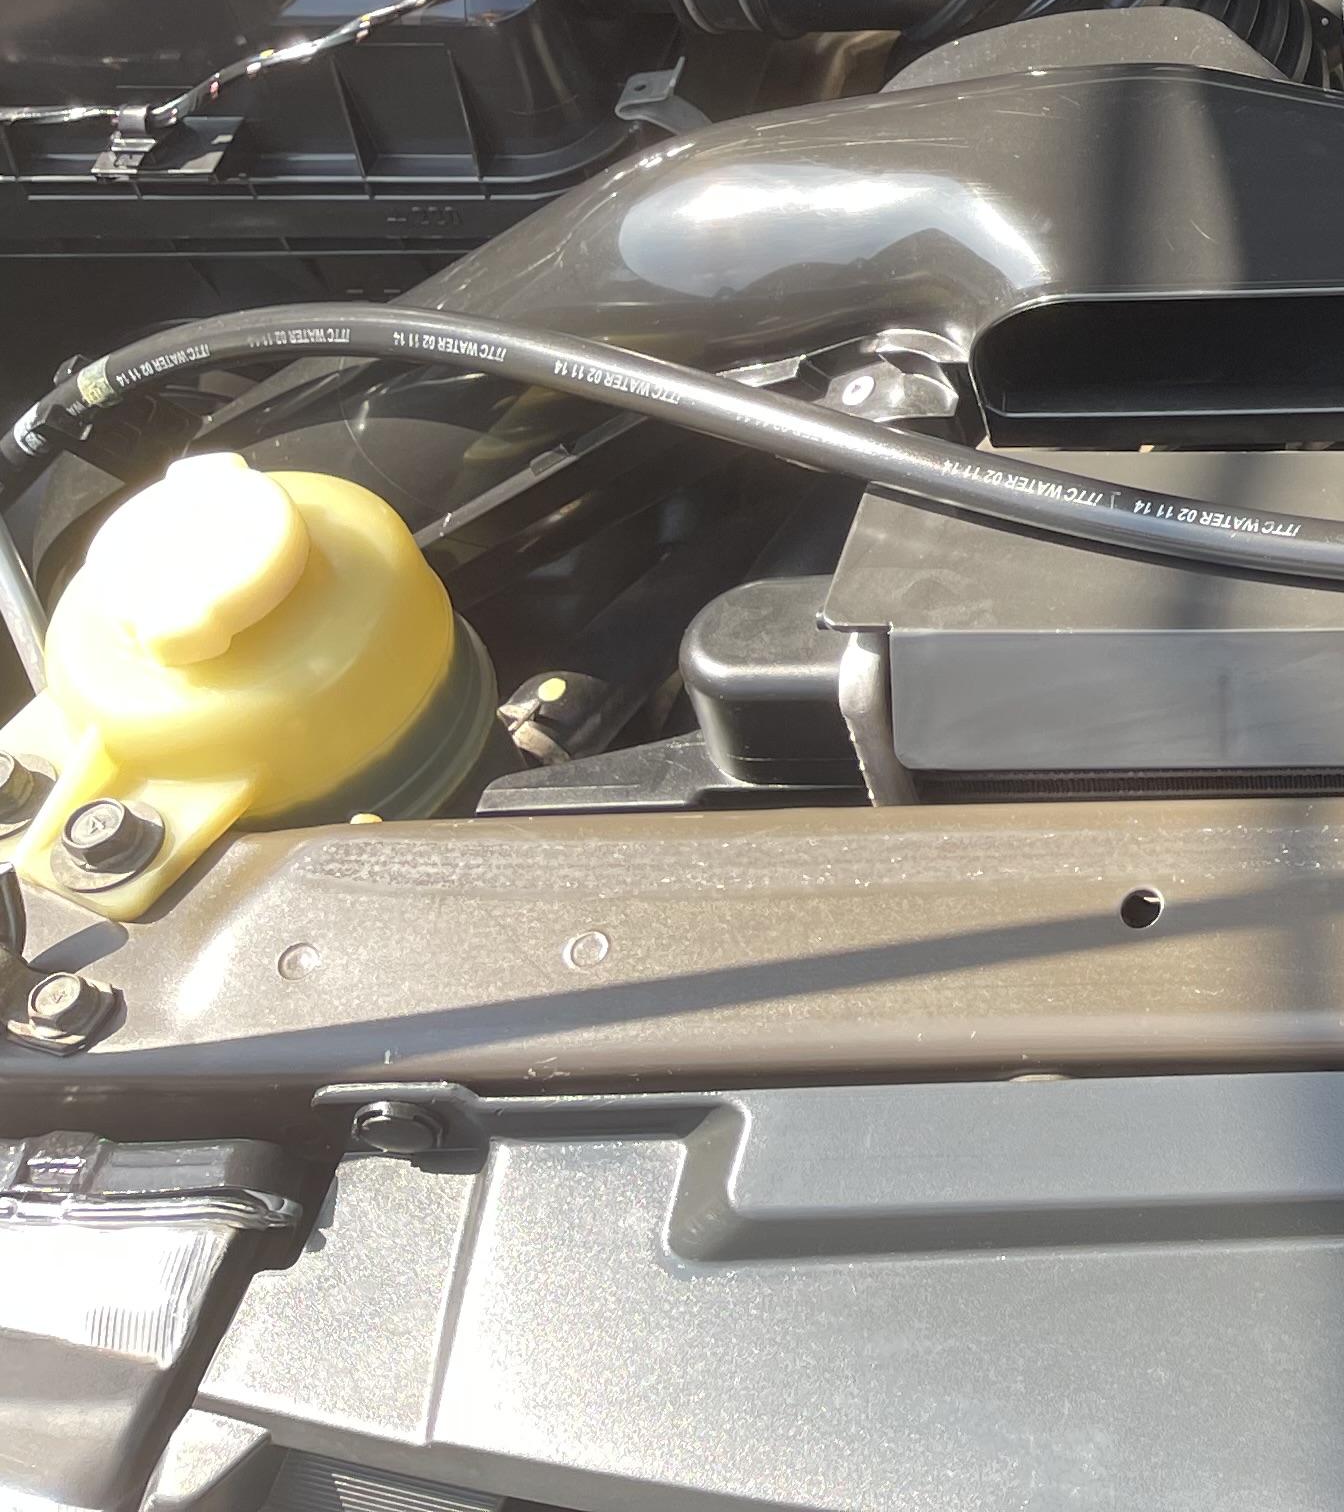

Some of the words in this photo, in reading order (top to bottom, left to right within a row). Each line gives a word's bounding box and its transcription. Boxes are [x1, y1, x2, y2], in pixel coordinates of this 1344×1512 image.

[288, 328, 328, 345] WATER
[393, 331, 406, 346] 14
[408, 332, 420, 348] 11
[422, 334, 436, 349] 02
[438, 336, 480, 360] WATER
[141, 362, 153, 376] 02
[151, 350, 187, 373] WATER
[554, 359, 569, 376] 14
[570, 364, 585, 380] 11
[586, 367, 604, 385] 02
[604, 371, 652, 398] WATER
[962, 463, 981, 481] 11
[984, 468, 1003, 486] 02
[1006, 473, 1064, 501] WATER
[1133, 499, 1154, 516] 14
[1155, 503, 1175, 519] 11
[1177, 507, 1199, 524] 02
[1199, 510, 1262, 534] WATER
